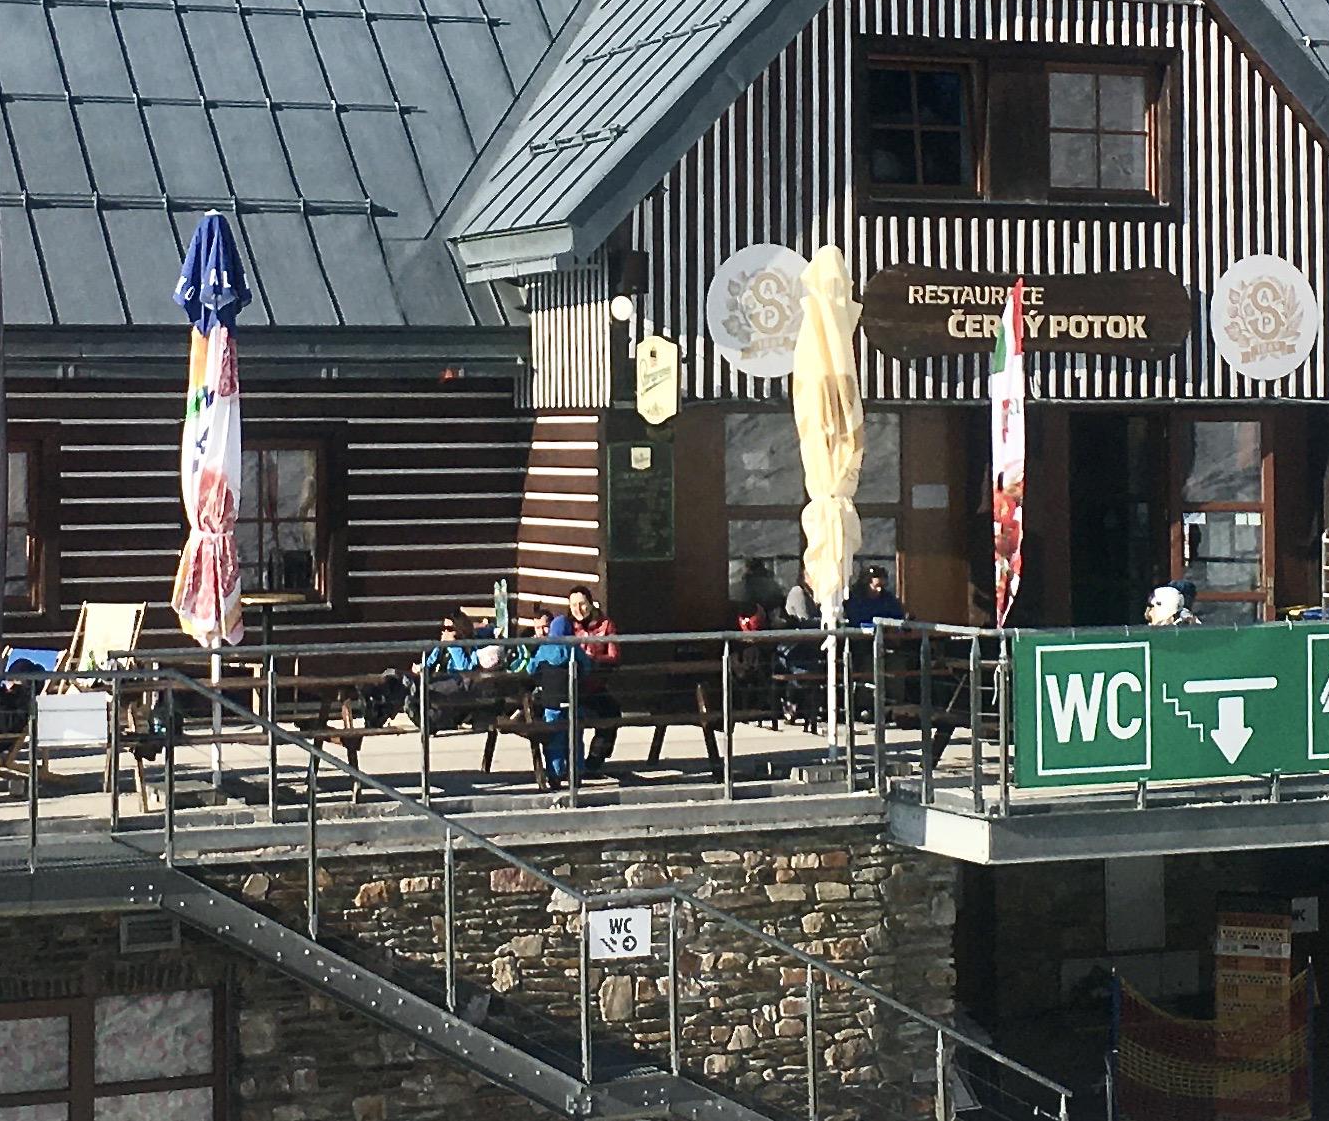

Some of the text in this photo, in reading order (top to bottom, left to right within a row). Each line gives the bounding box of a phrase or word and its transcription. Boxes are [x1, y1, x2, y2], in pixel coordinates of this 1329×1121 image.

[907, 285, 1045, 305] RESTAURCE
[947, 308, 1148, 339] ČERÝ POTOK
[1044, 671, 1143, 744] WC
[609, 917, 633, 934] WC
